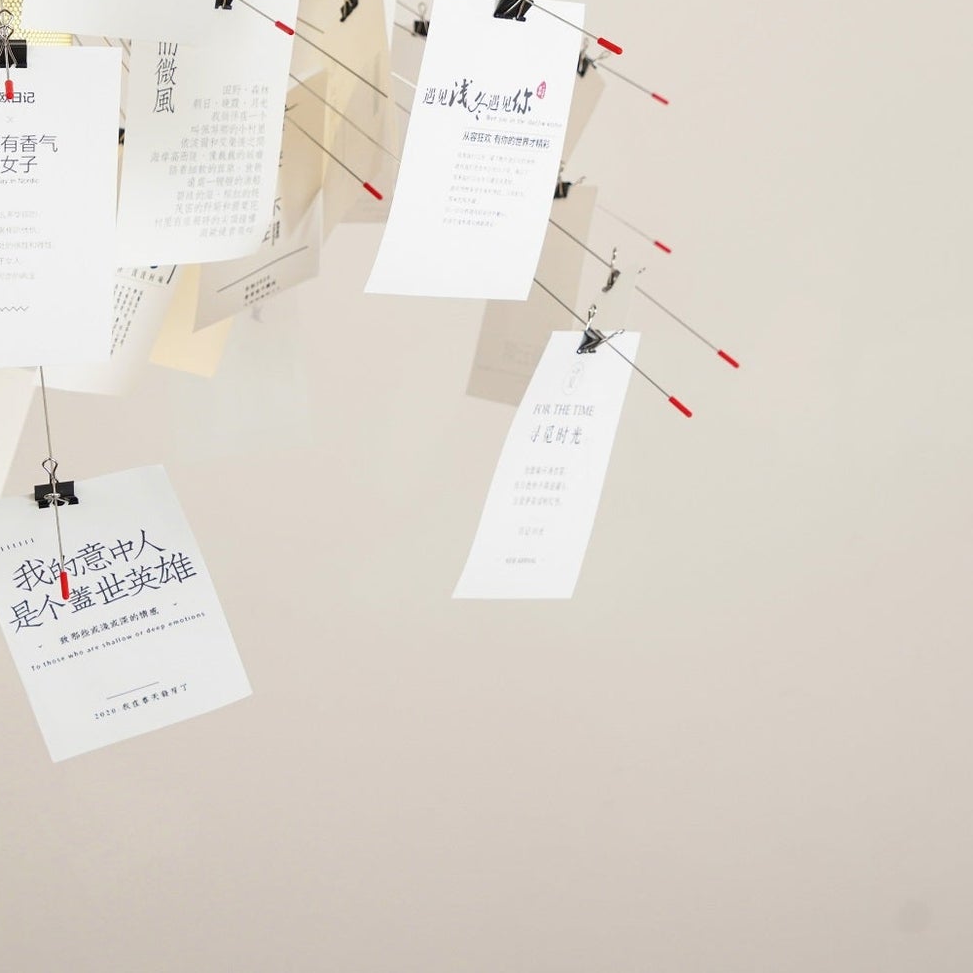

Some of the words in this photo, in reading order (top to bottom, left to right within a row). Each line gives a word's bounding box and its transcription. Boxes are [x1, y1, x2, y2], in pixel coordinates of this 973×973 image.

[553, 403, 571, 416] THE
[573, 404, 595, 417] TIME
[12, 529, 167, 592] 我的意中人
[67, 648, 84, 660] who
